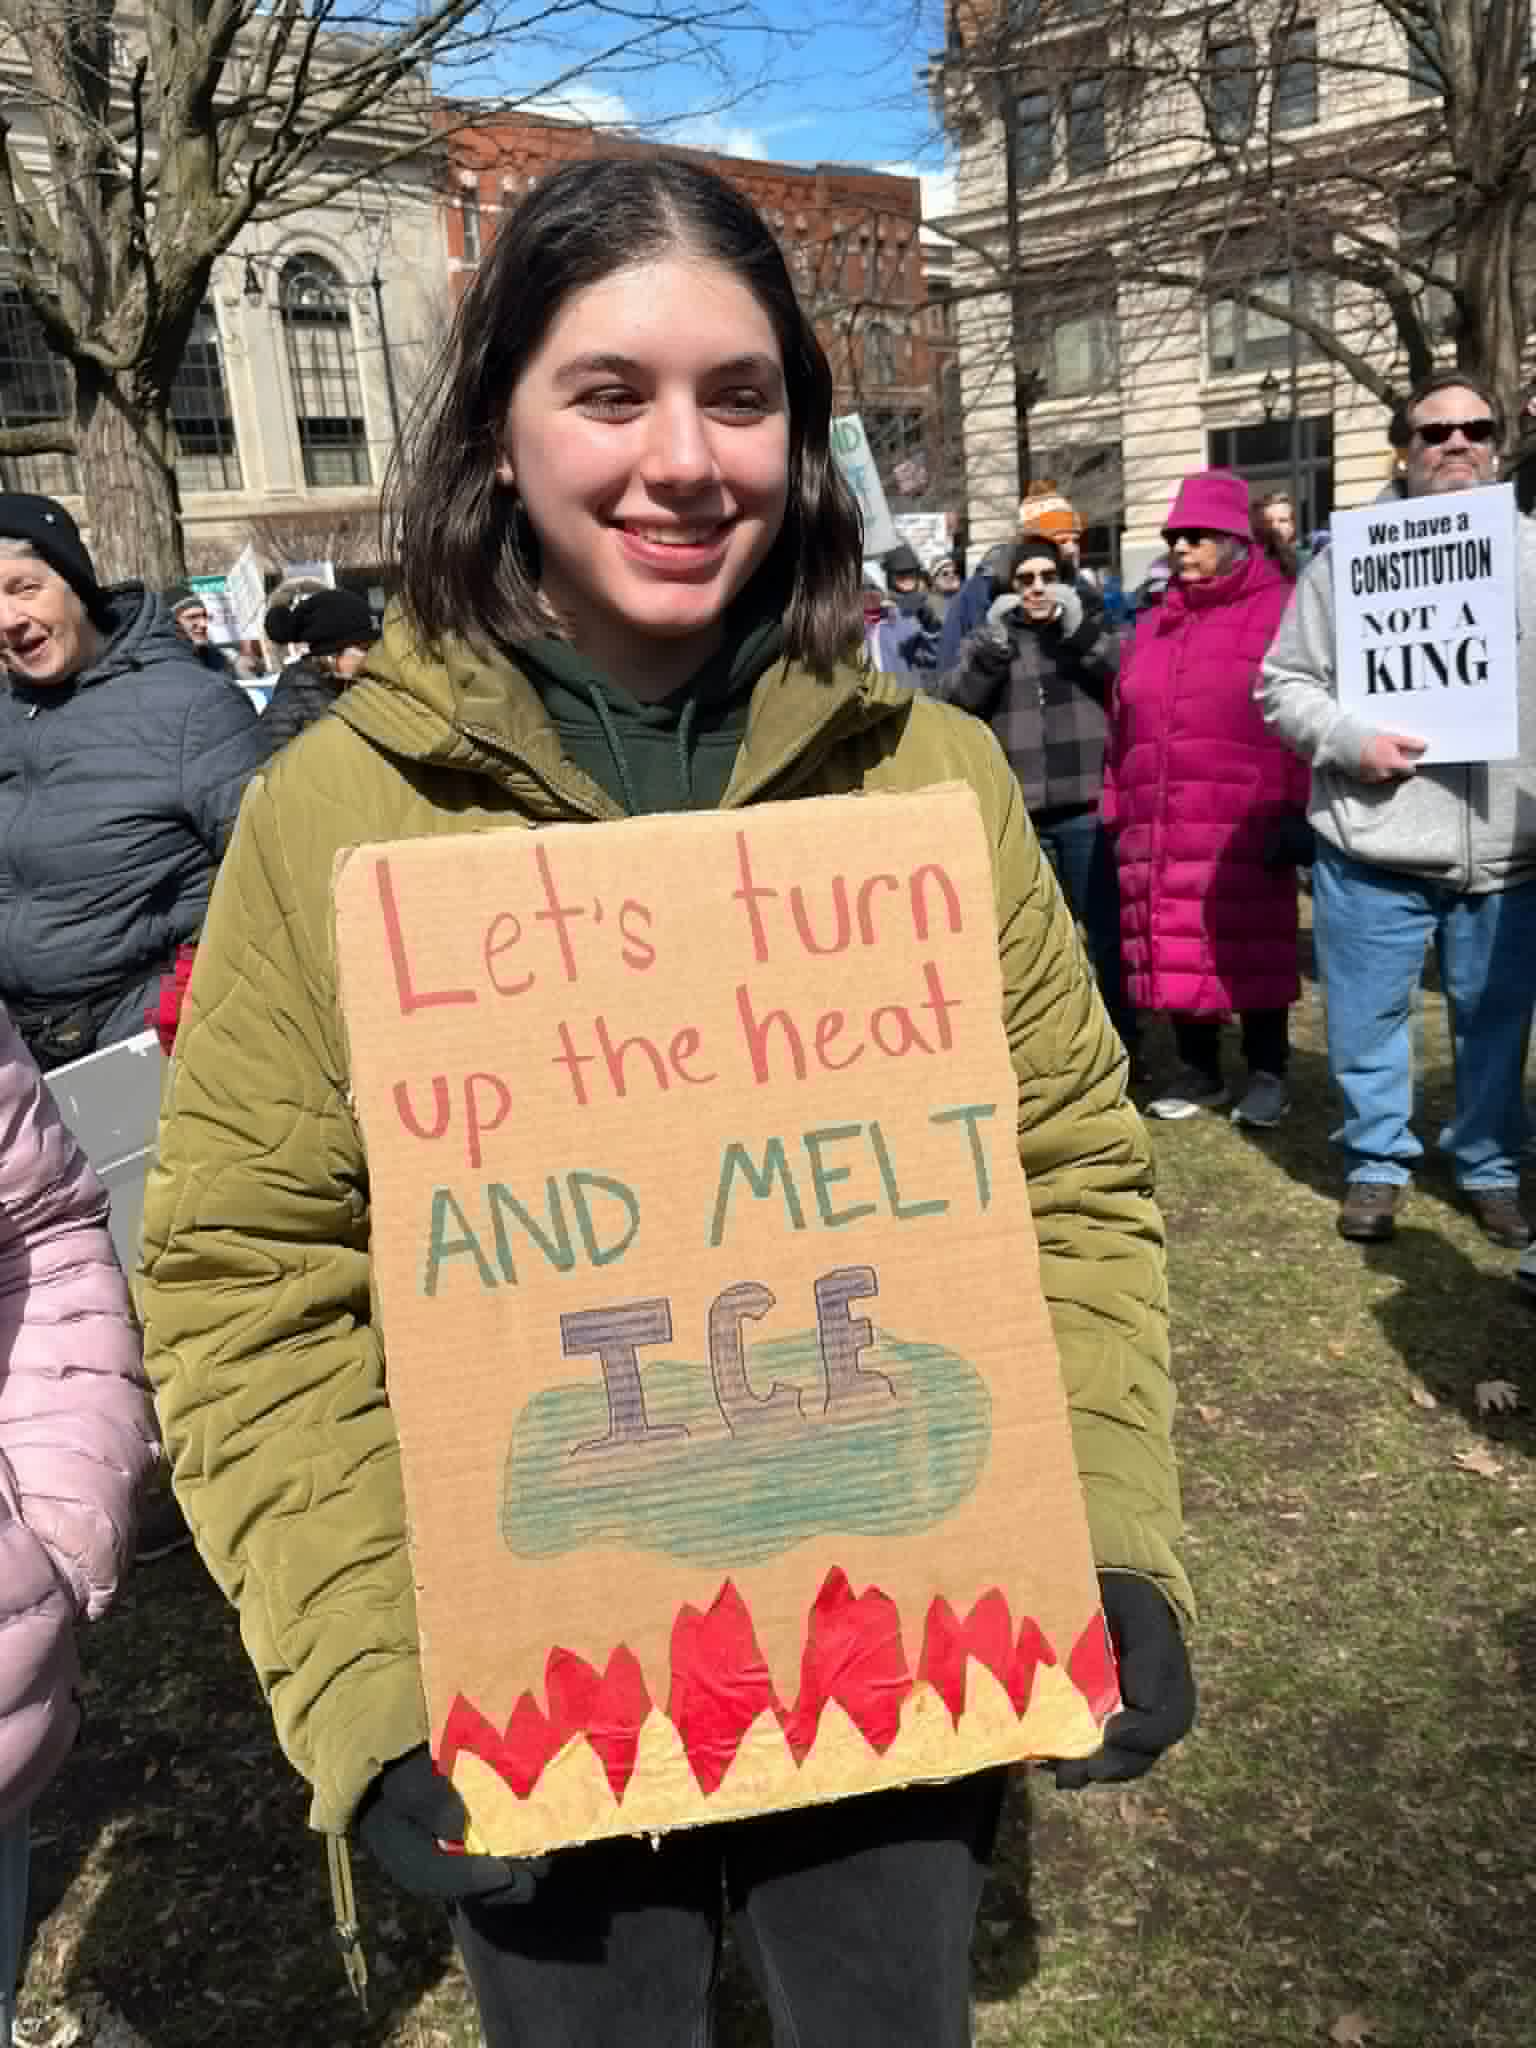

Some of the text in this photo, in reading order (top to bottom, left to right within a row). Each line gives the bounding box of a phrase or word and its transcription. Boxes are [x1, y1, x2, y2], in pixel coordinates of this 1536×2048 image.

[1351, 537, 1492, 596] CONSTITUTION
[1368, 512, 1469, 545] We have a
[1361, 601, 1478, 637] NOT A
[1362, 636, 1491, 696] KING
[376, 831, 961, 1015] Let's turn
[393, 961, 961, 1168] up the heat
[424, 1103, 997, 1296] AND MELT
[560, 1264, 897, 1456] ICE
